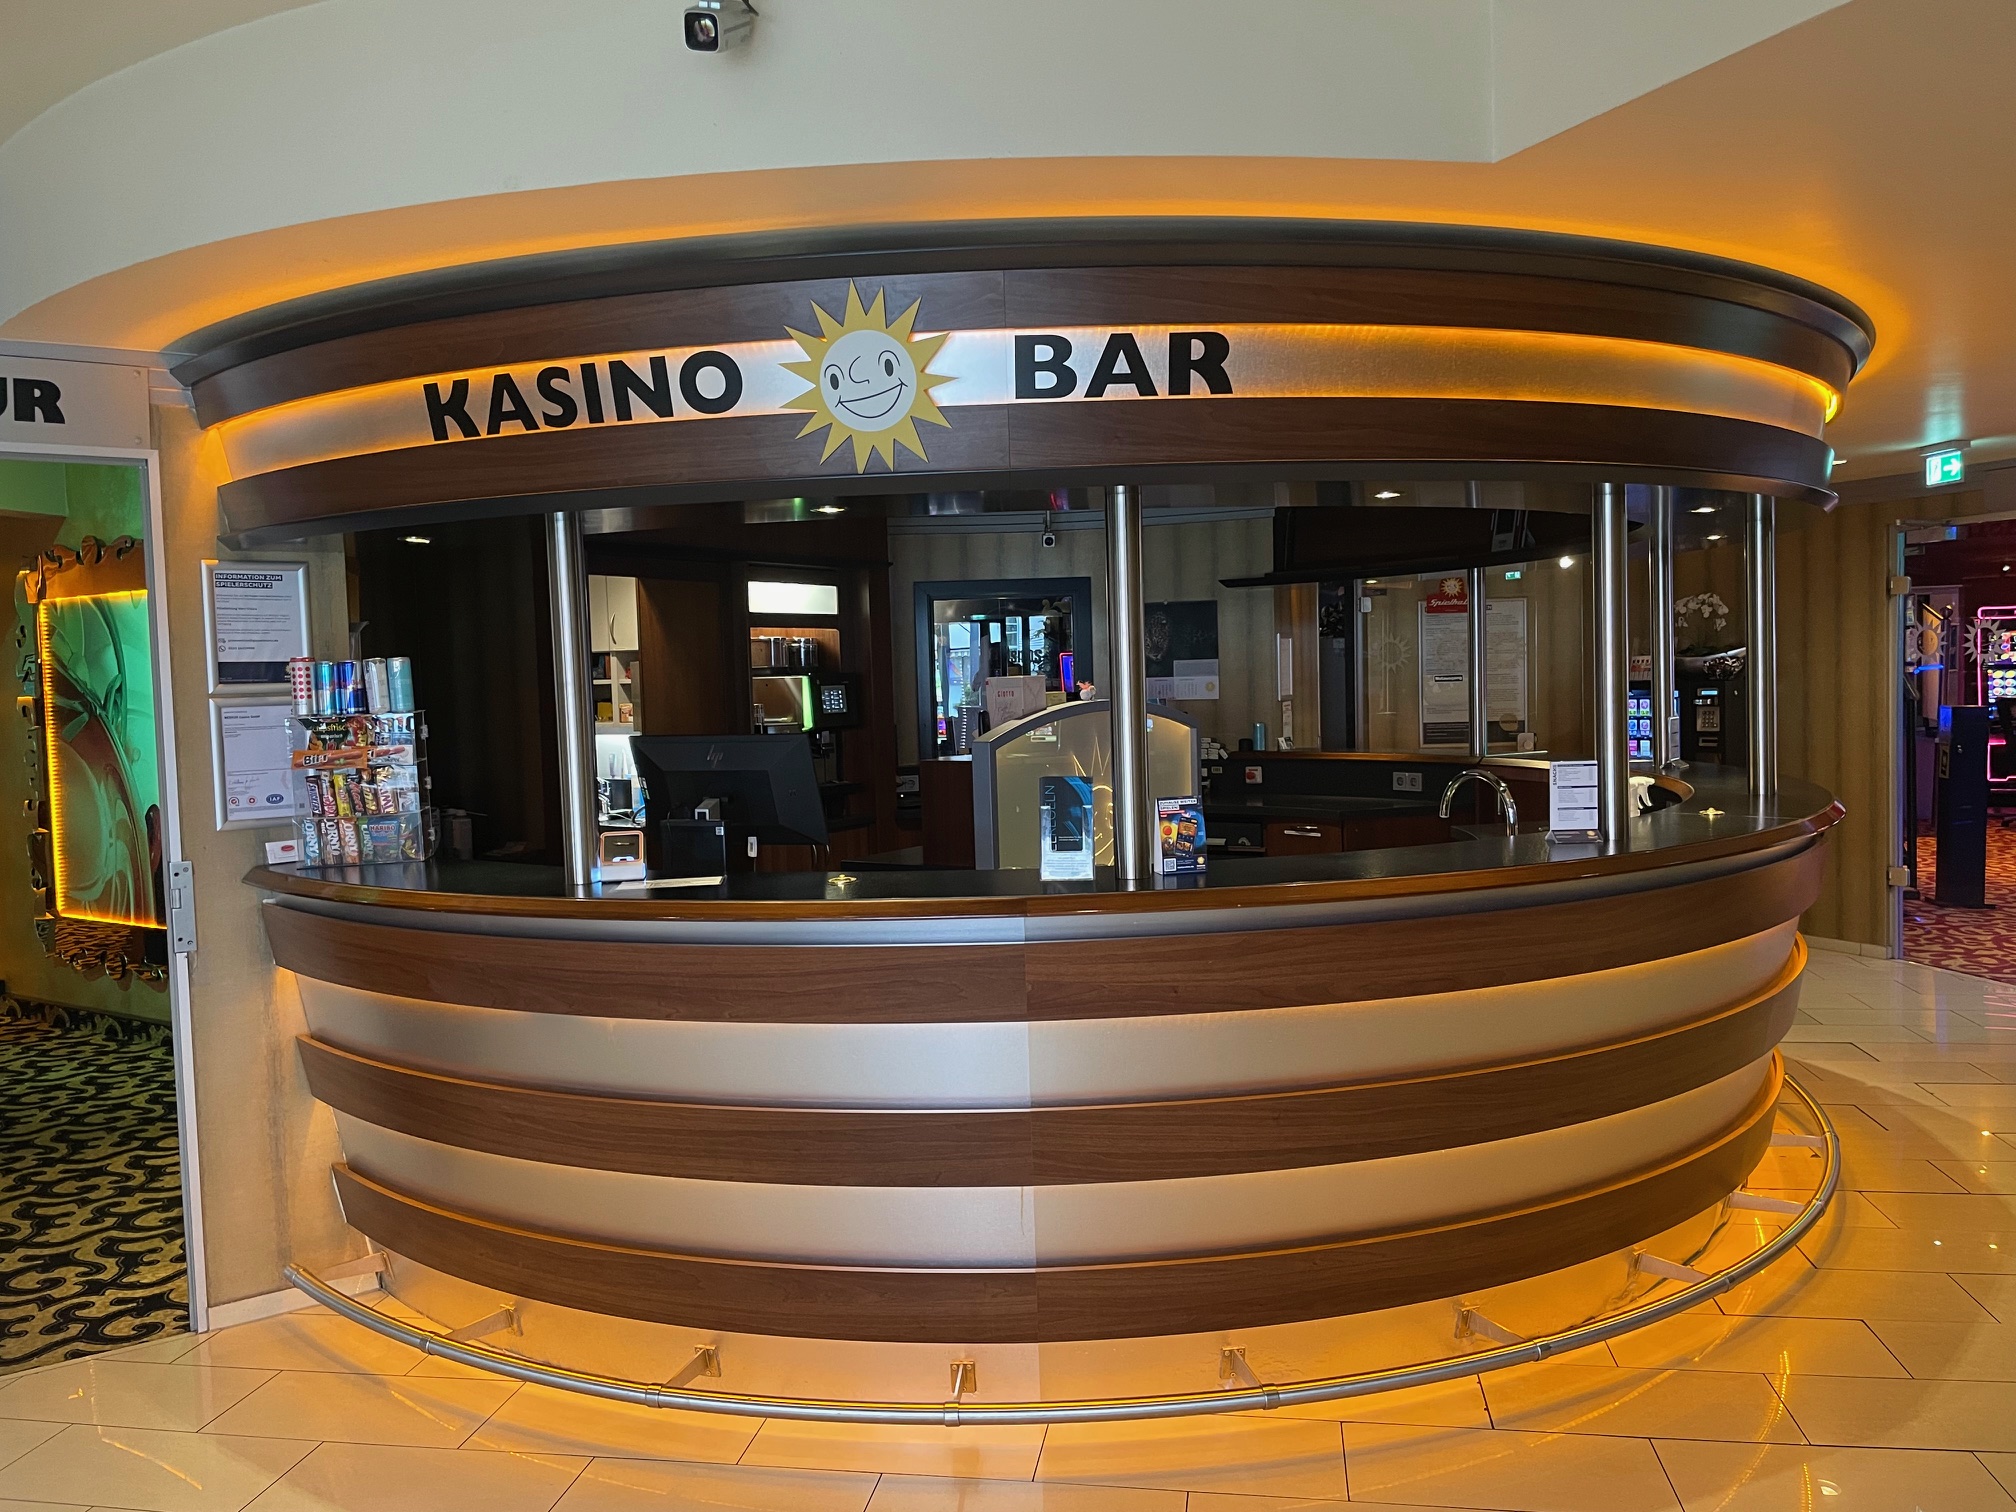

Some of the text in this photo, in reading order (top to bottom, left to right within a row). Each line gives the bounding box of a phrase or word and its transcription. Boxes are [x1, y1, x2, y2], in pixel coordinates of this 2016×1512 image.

[0, 377, 66, 425] R
[423, 331, 1233, 441] KASINO BAR
[706, 744, 724, 769] hp
[308, 783, 321, 814] SNICKERS
[369, 824, 396, 832] HARIBO
